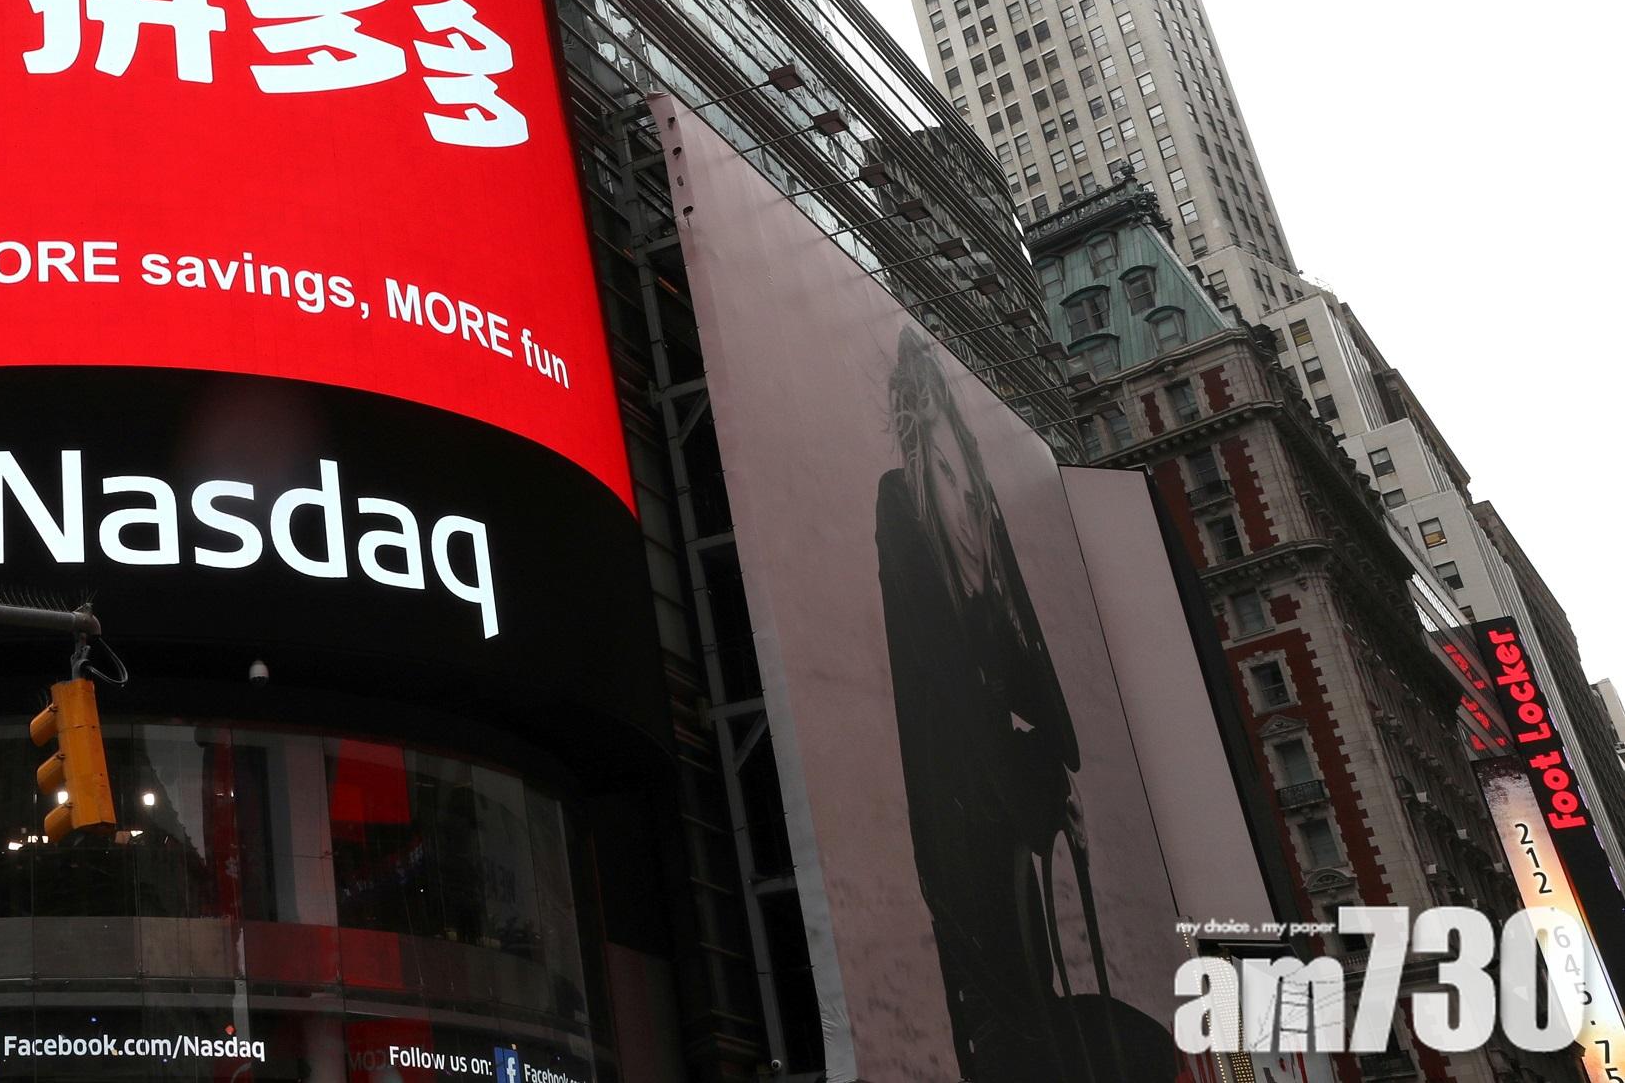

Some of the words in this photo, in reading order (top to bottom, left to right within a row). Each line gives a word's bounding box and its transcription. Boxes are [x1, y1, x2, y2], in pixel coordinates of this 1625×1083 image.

[141, 253, 370, 319] savings,
[386, 278, 513, 358] MORE
[520, 329, 570, 390] fun
[1488, 630, 1552, 743] Locker
[1529, 750, 1587, 829] Foot
[4, 1034, 266, 1062] Facebook.com/Nasdaq
[389, 1046, 444, 1070] Follow
[450, 1055, 468, 1073] us
[471, 1058, 493, 1076] on:
